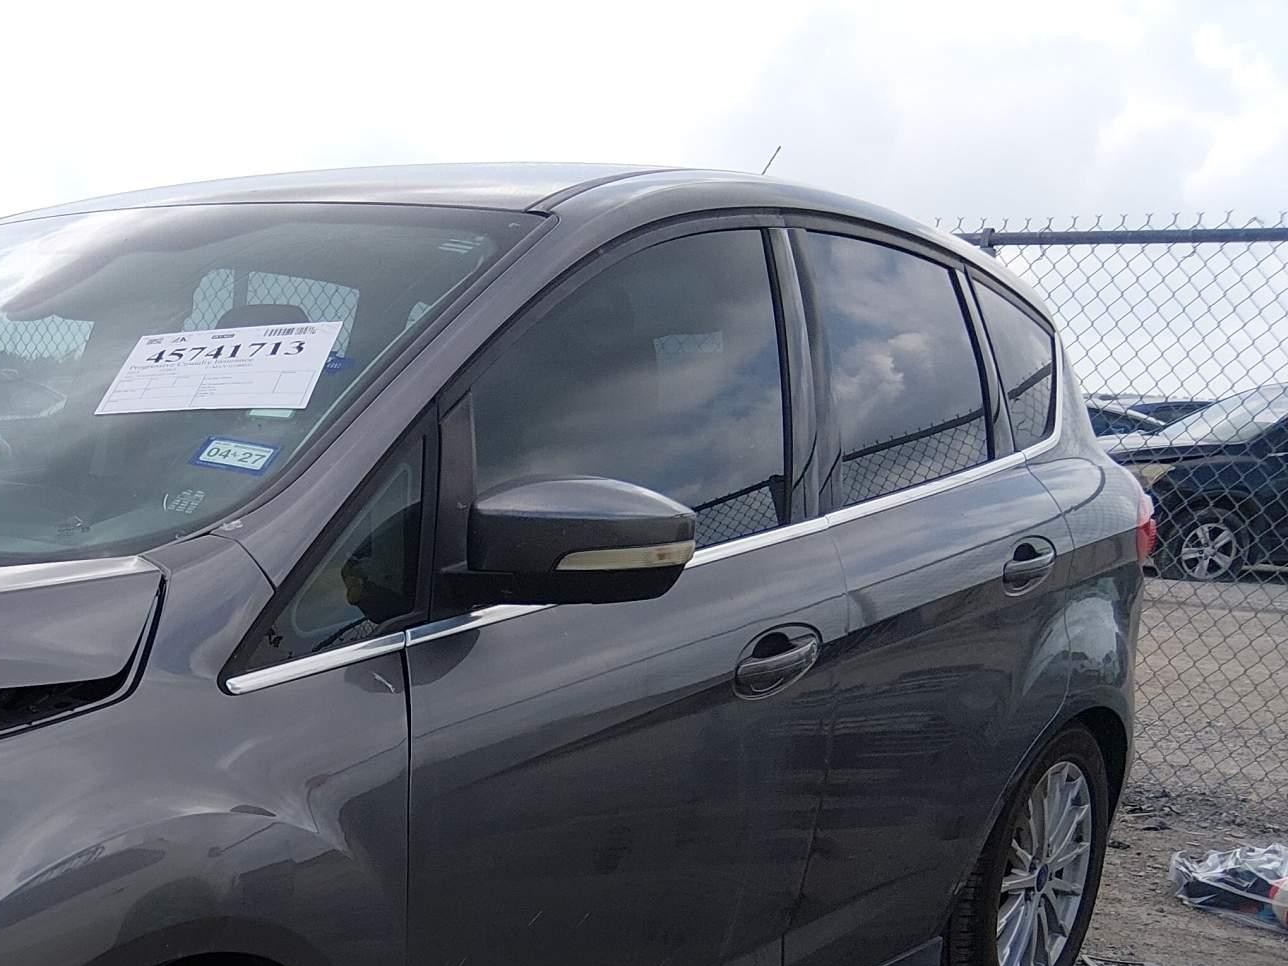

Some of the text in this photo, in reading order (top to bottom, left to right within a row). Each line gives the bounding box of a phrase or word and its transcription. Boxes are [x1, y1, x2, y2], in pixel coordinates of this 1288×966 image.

[145, 340, 306, 363] 45741713
[206, 446, 267, 465] 04 27
